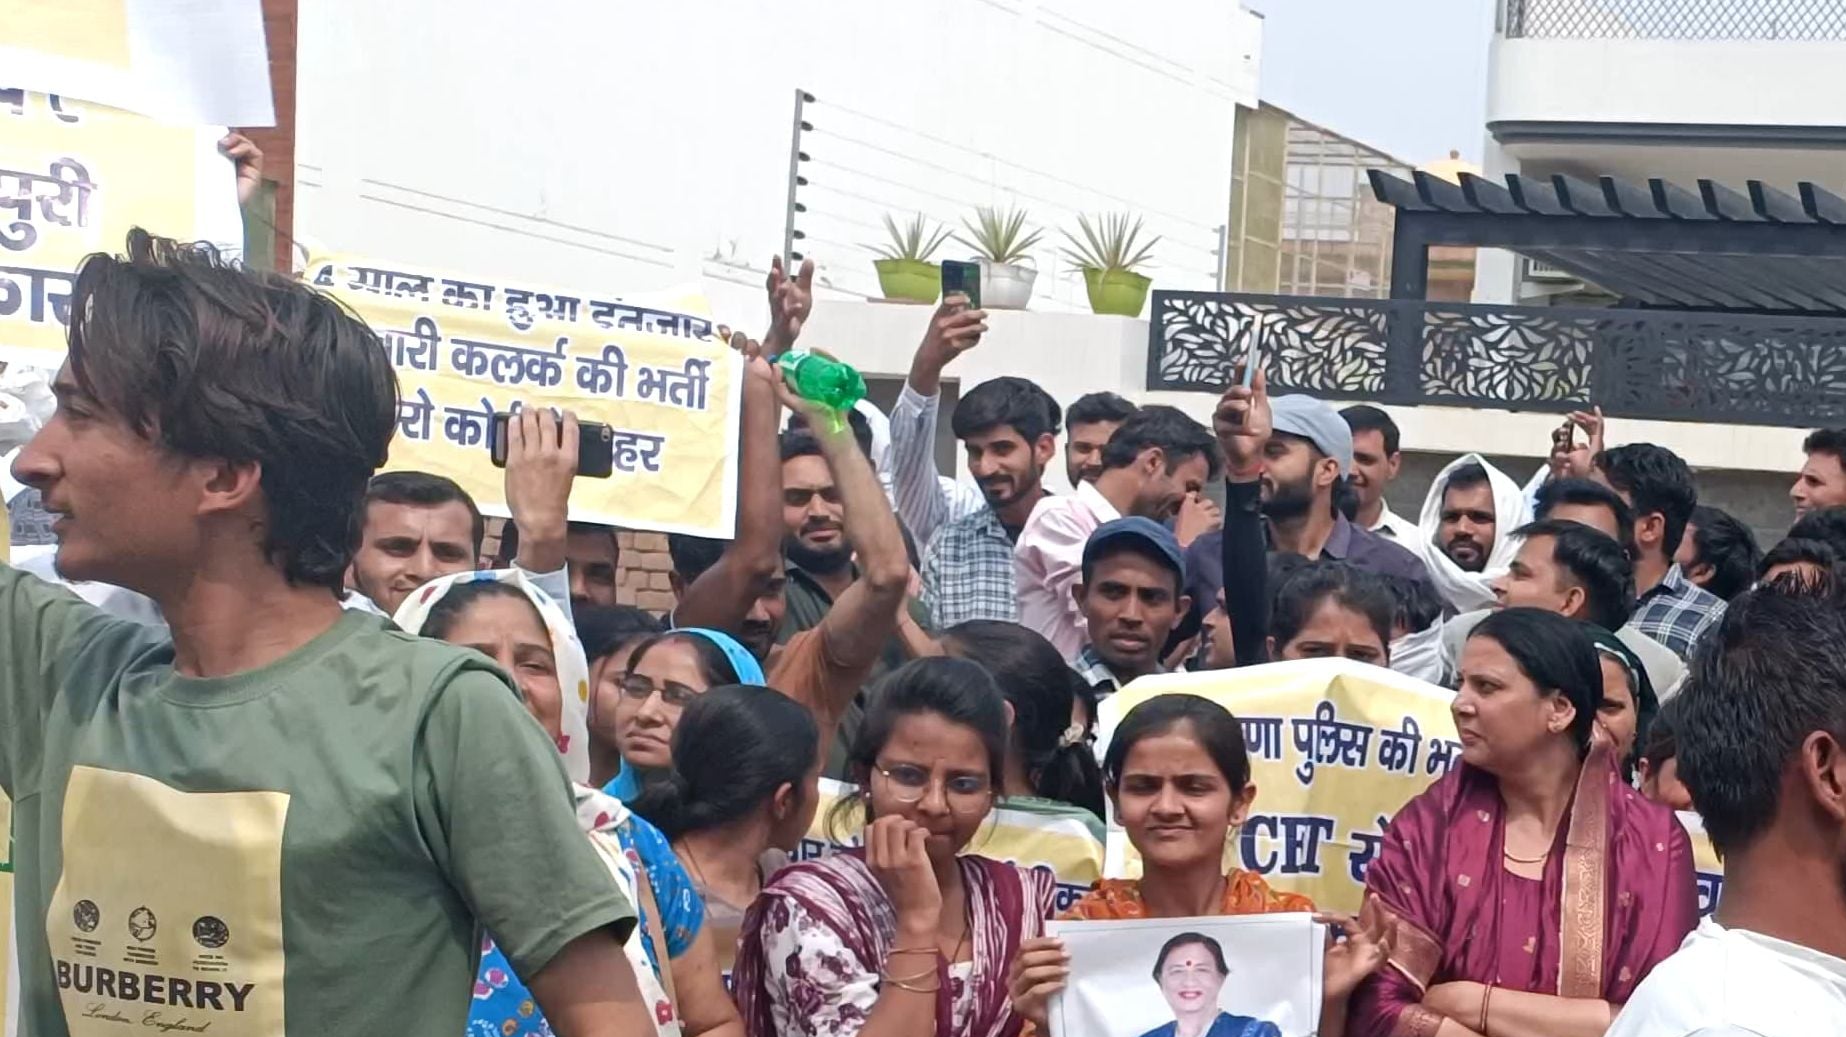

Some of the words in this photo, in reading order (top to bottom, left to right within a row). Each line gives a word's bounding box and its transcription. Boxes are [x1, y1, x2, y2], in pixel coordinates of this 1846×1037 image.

[450, 337, 569, 387] कलर्क
[575, 345, 629, 397] की
[637, 358, 712, 410] भर्ती
[1378, 716, 1422, 774] की
[58, 960, 256, 1013] BURBERRY
